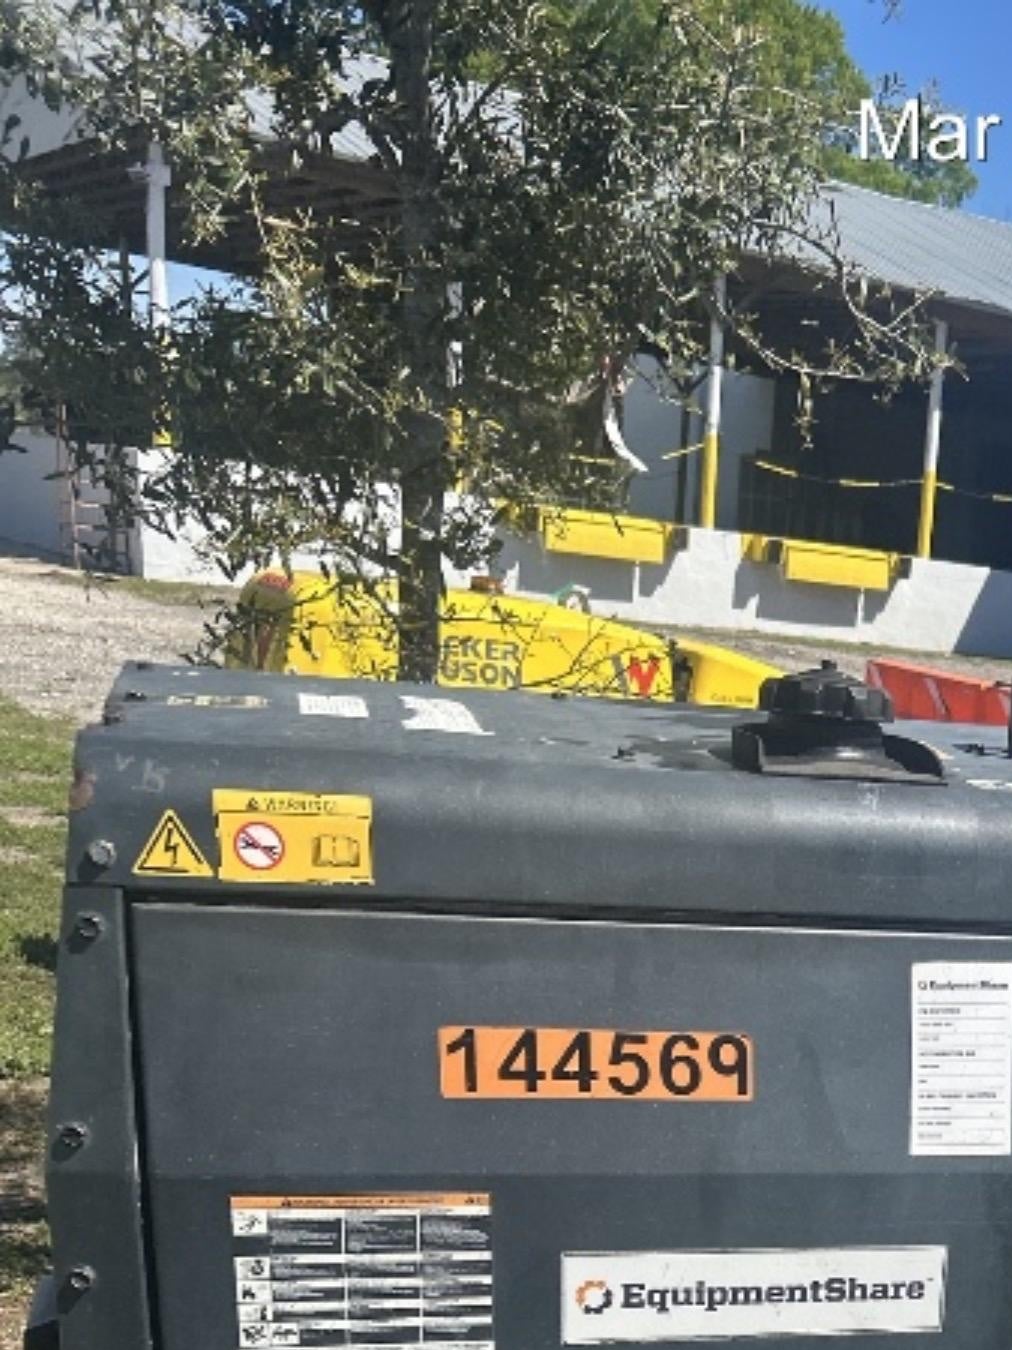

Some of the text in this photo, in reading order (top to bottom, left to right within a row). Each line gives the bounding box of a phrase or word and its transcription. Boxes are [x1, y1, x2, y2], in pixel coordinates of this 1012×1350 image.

[442, 634, 521, 662] CKER
[440, 659, 522, 690] USON
[445, 1027, 750, 1096] 144569
[619, 1276, 926, 1314] EquipmentShare
